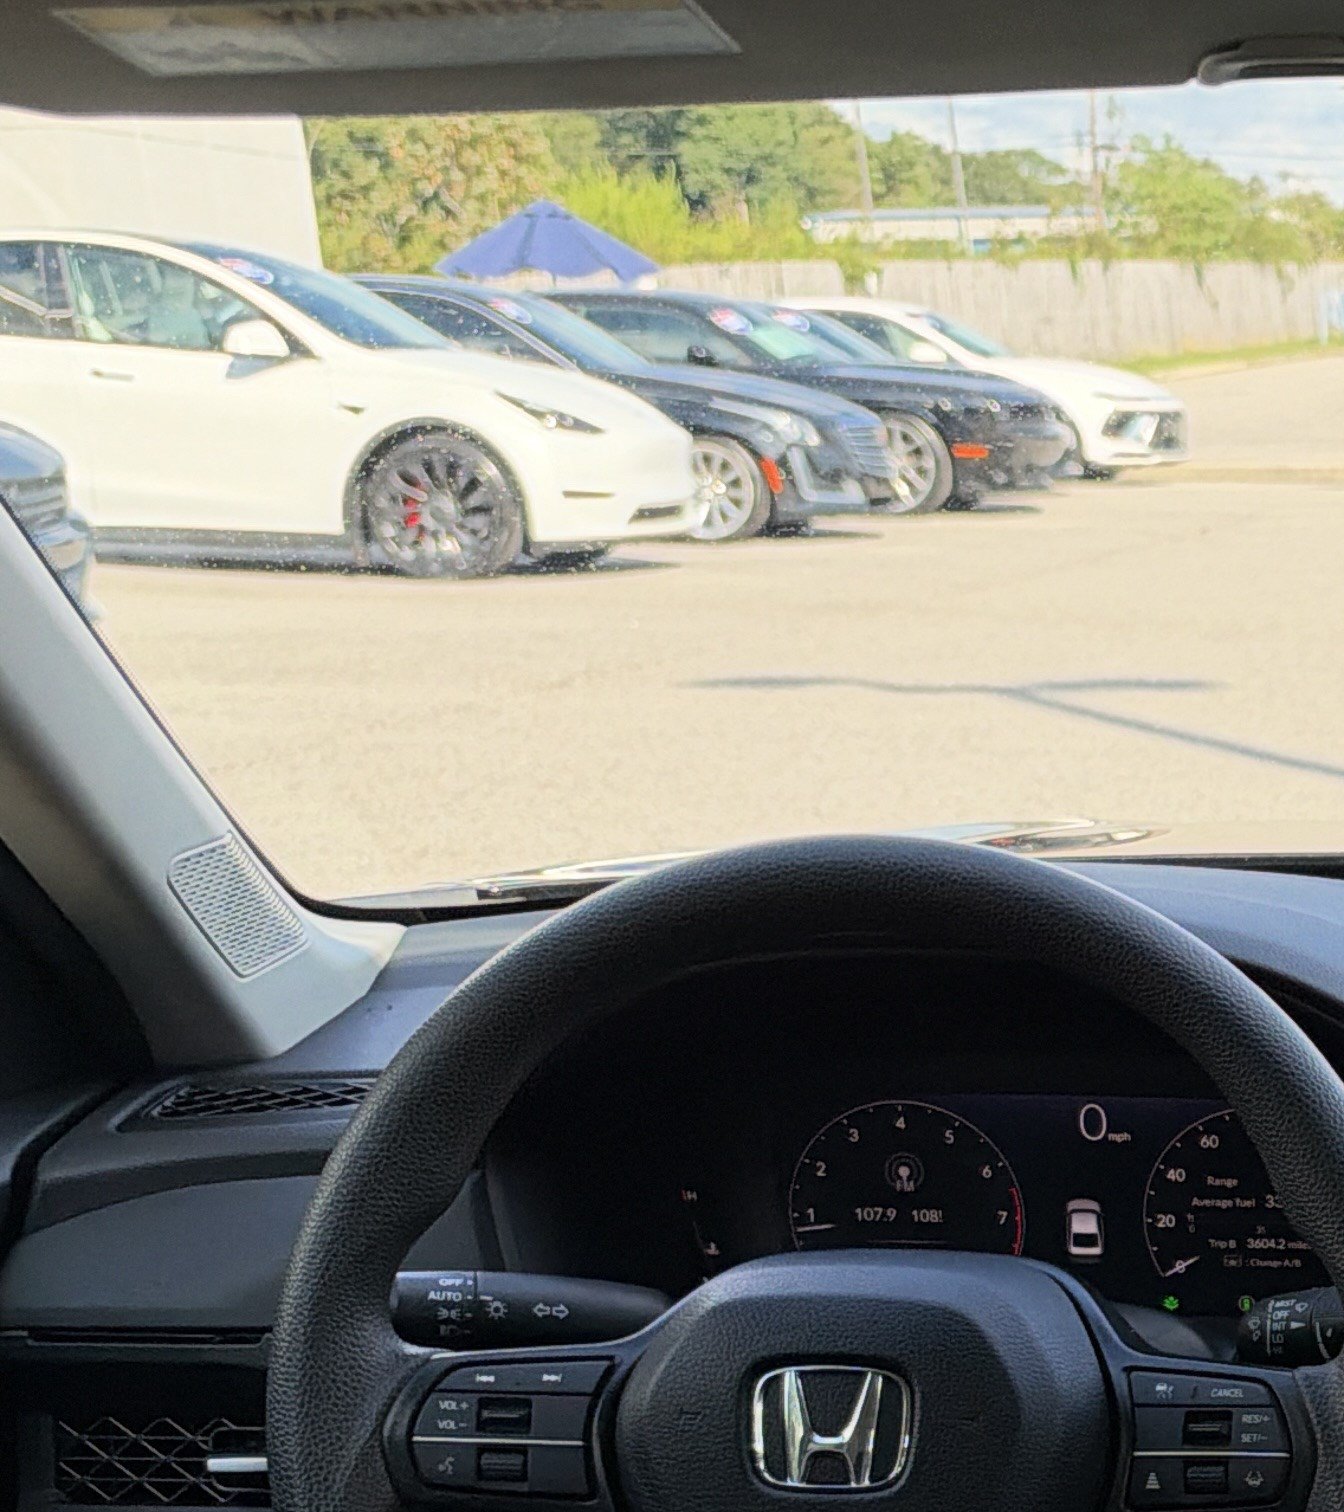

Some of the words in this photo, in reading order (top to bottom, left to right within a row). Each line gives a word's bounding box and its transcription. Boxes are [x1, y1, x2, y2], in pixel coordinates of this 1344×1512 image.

[895, 1116, 906, 1130] 4
[1080, 1103, 1107, 1141] 0
[1108, 1132, 1132, 1143] mph
[848, 1127, 859, 1143] 3
[944, 1129, 955, 1144] 5
[1200, 1134, 1220, 1149] 60
[815, 1160, 827, 1177] 2
[981, 1164, 992, 1179] 6
[1166, 1168, 1187, 1182] 40
[1206, 1176, 1239, 1188] Range
[1191, 1197, 1234, 1209] Average
[856, 1207, 897, 1222] 107.9
[996, 1209, 1008, 1225] 7
[1156, 1213, 1176, 1228] 20
[428, 1290, 463, 1302] AUTO
[1210, 1388, 1244, 1398] CANCEL
